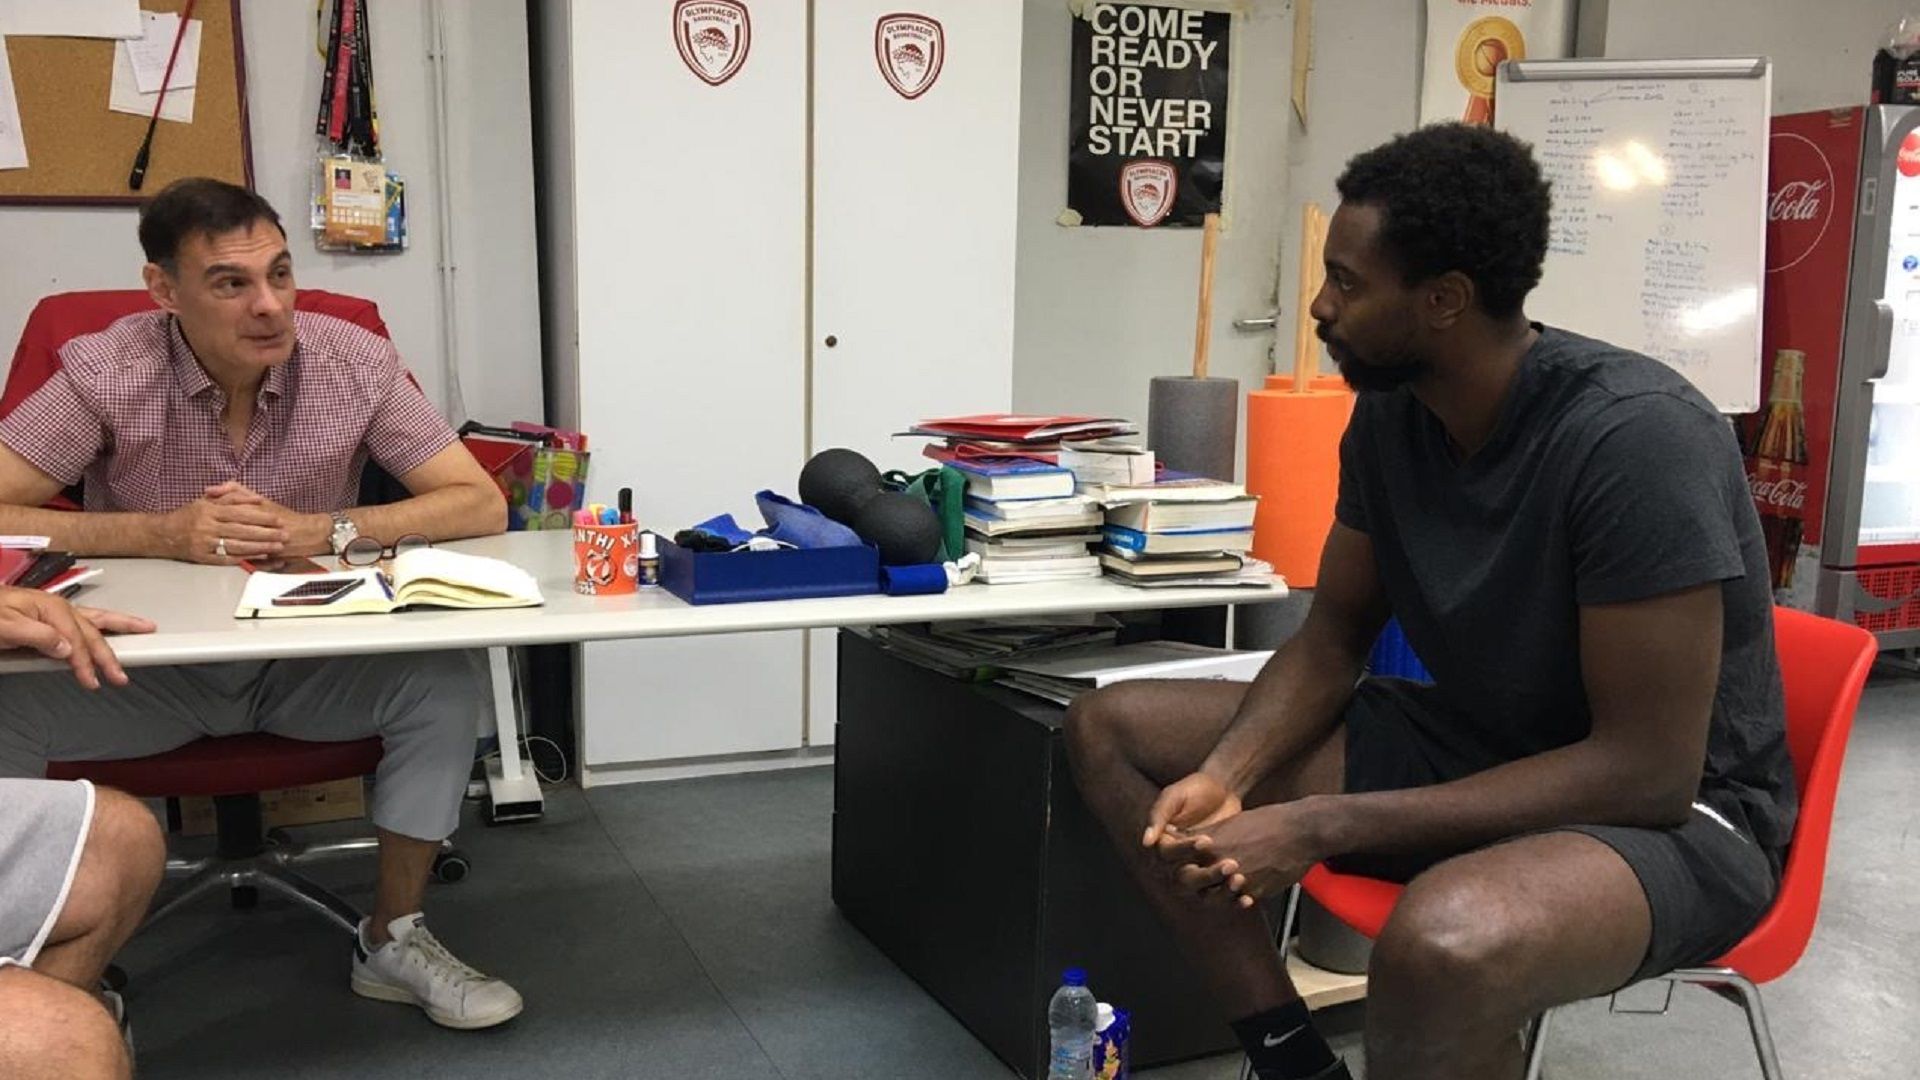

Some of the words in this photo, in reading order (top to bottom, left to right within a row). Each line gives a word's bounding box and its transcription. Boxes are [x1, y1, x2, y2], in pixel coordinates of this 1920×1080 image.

[685, 7, 738, 20] OLYMPIACOS
[1091, 4, 1205, 40] COME
[1091, 35, 1218, 70] READY
[1090, 65, 1143, 97] OR
[1090, 95, 1211, 129] NEVER
[1088, 125, 1204, 158] START
